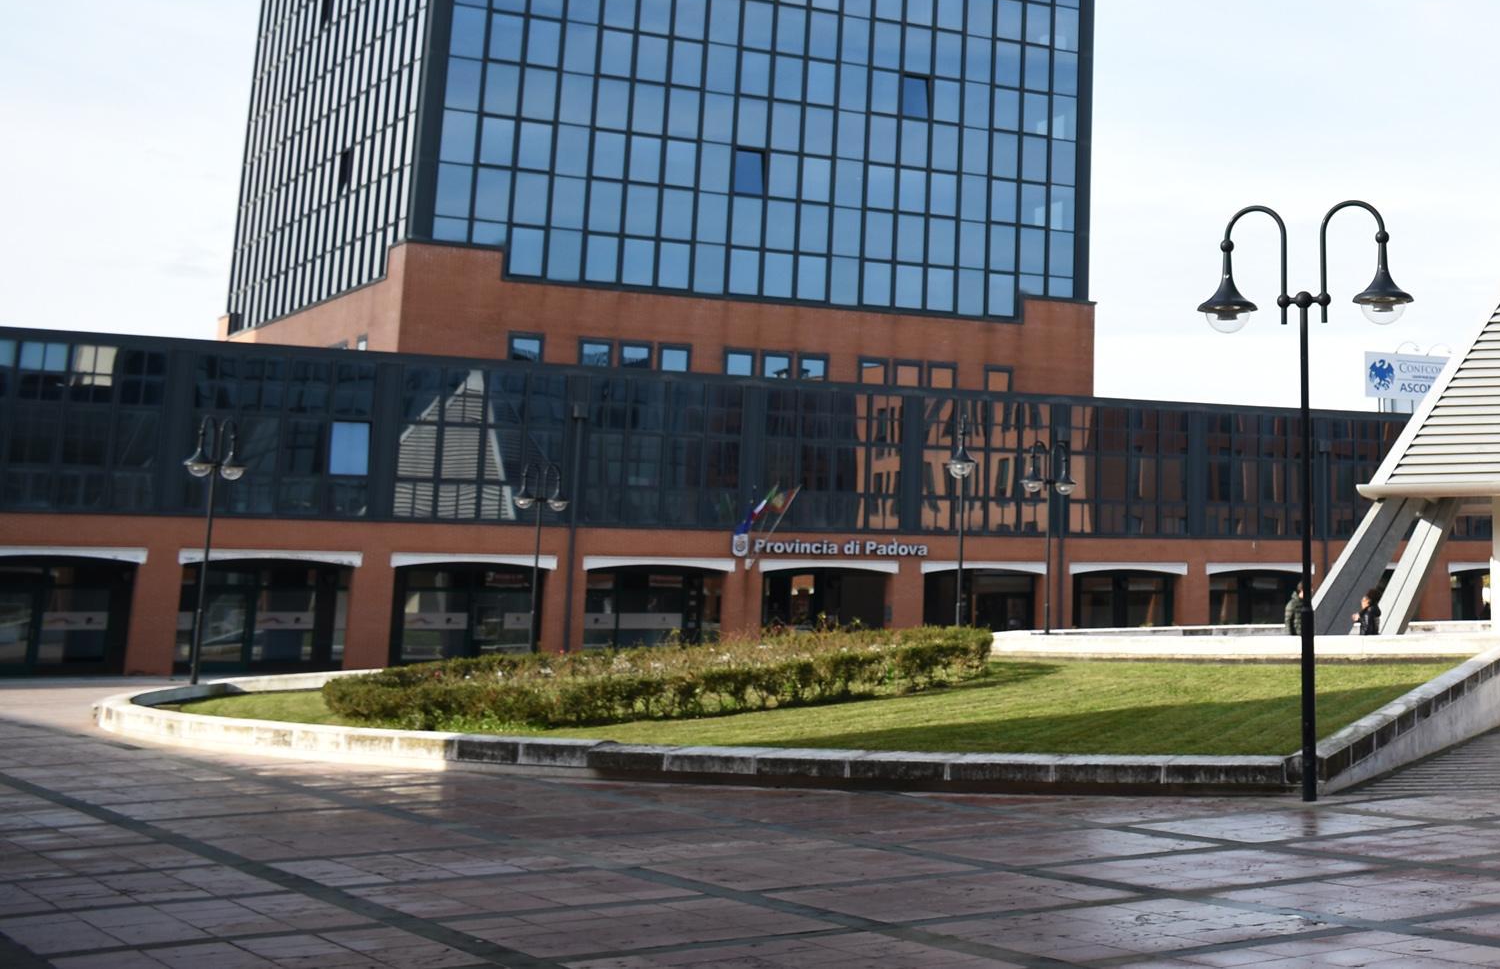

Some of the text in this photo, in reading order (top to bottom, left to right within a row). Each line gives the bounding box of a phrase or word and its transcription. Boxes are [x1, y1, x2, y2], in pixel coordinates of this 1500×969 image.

[754, 539, 928, 556] Provincia di Padova
